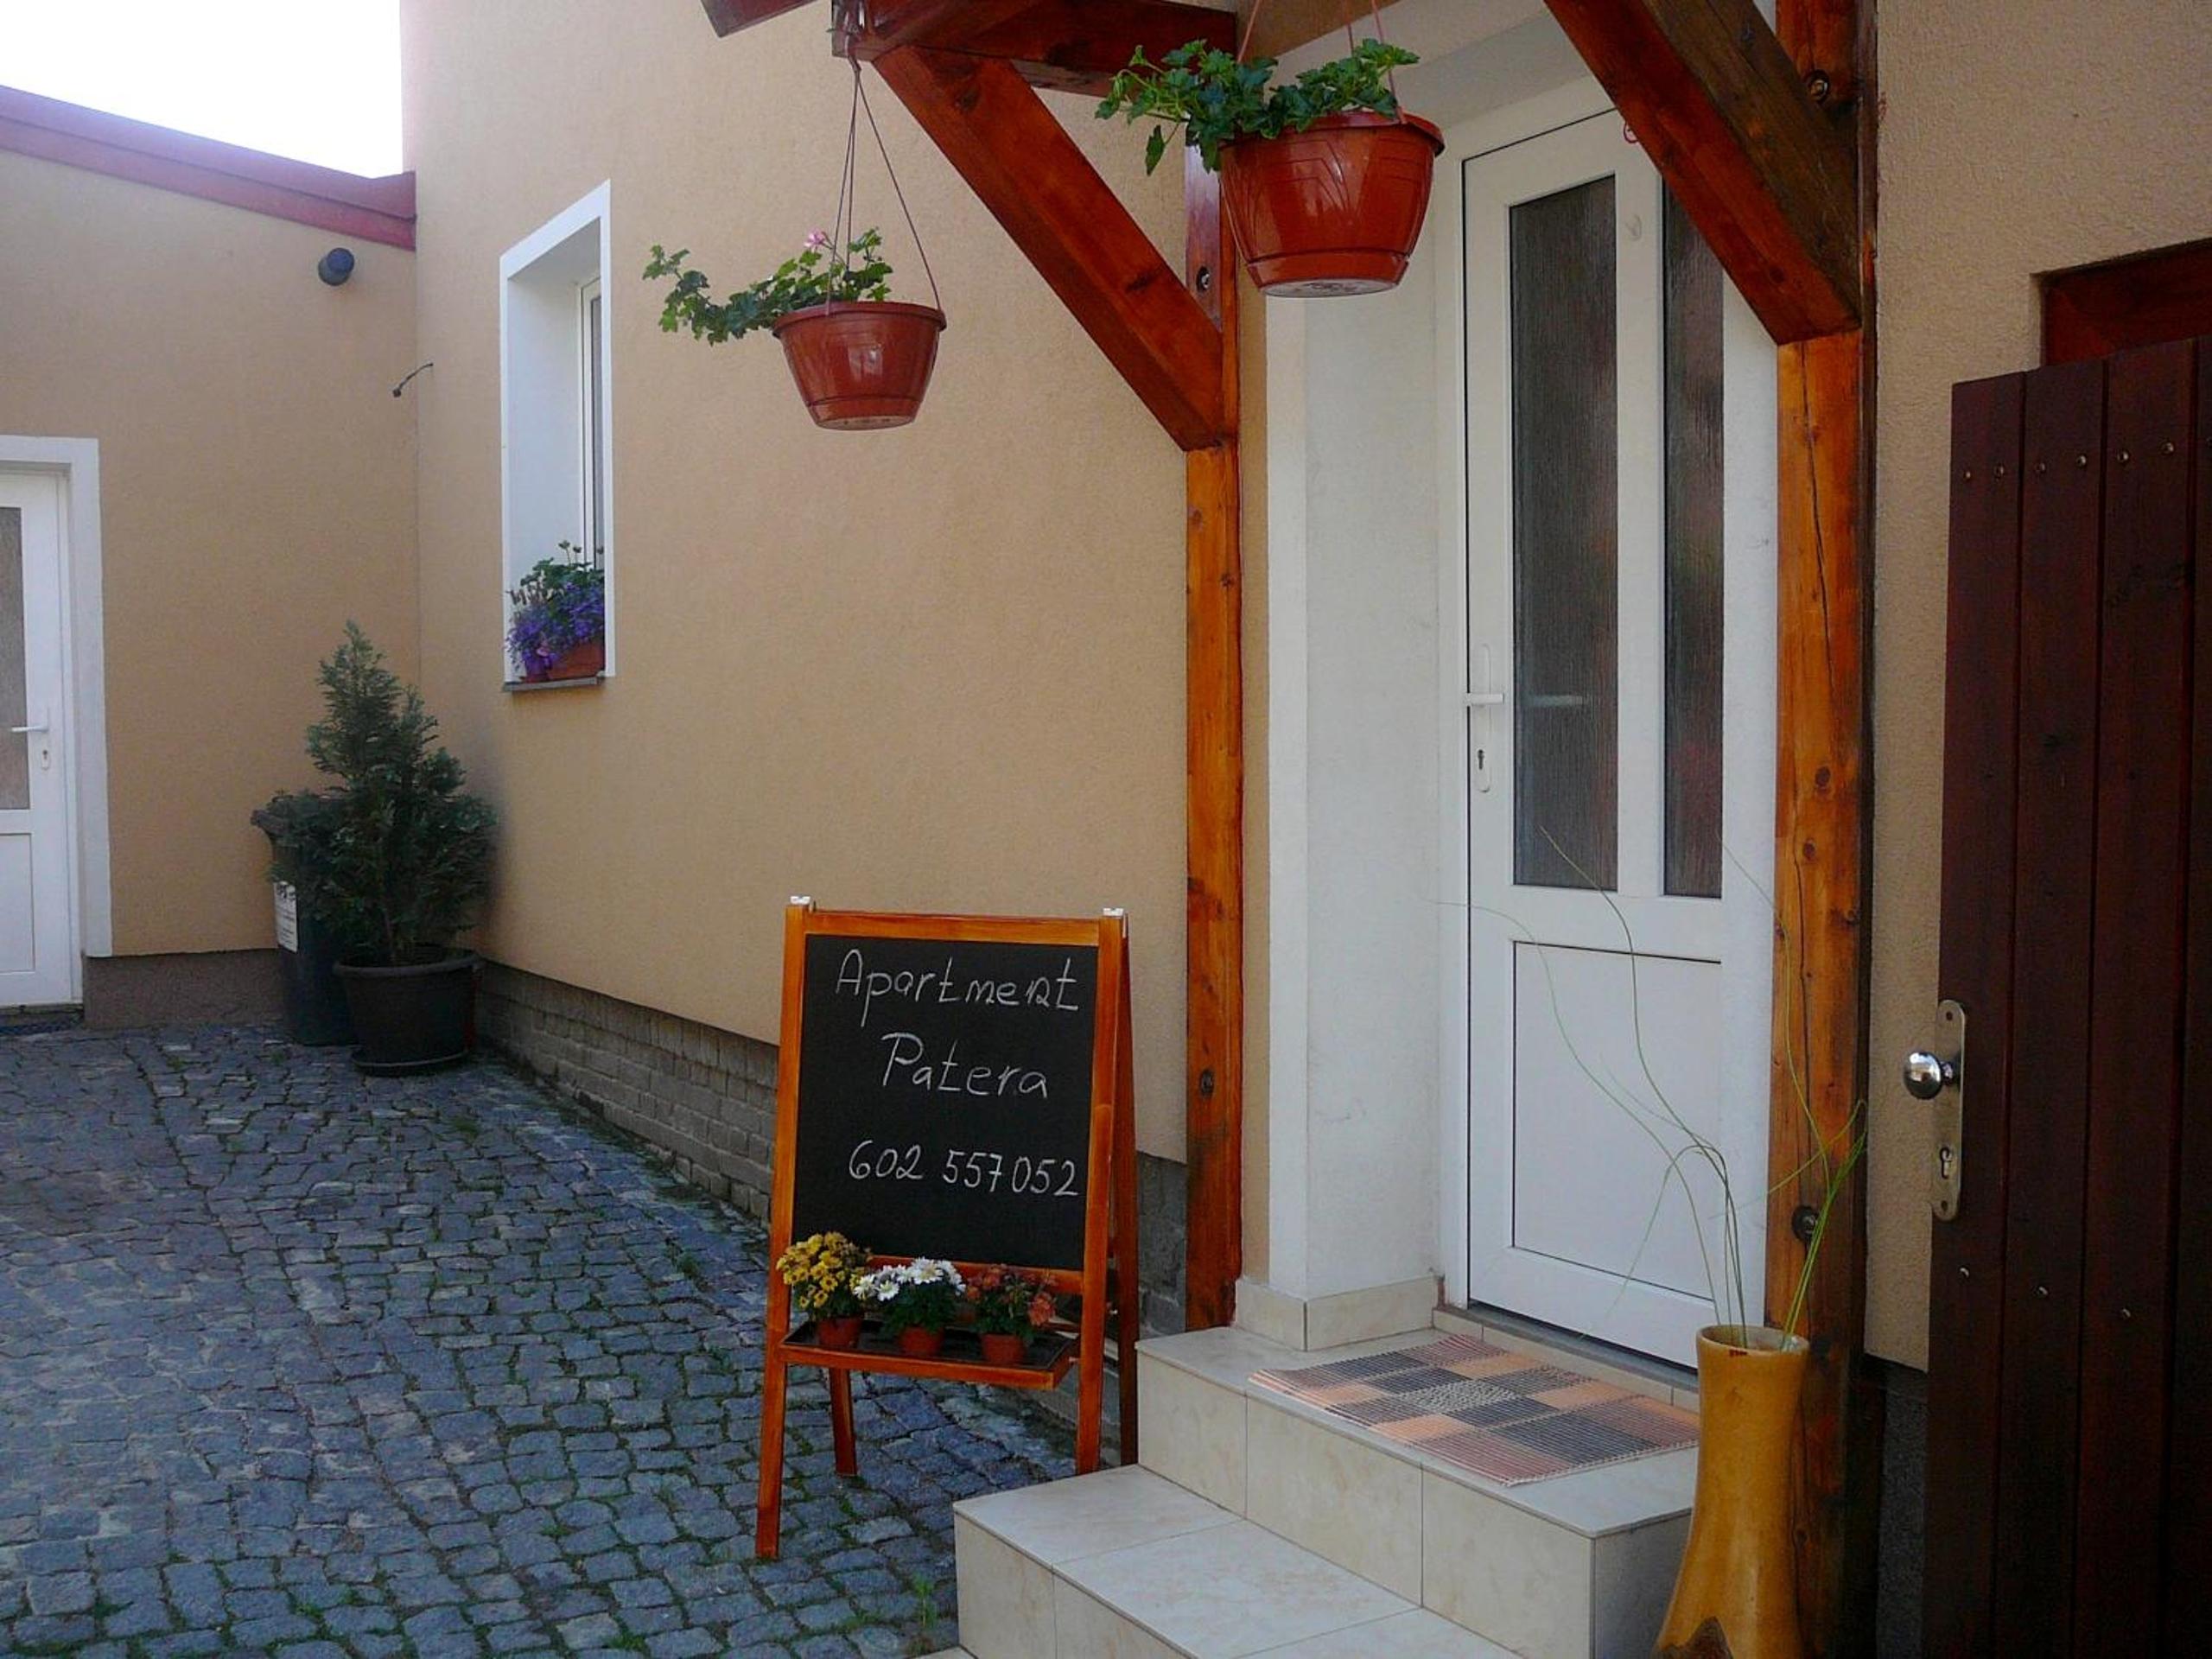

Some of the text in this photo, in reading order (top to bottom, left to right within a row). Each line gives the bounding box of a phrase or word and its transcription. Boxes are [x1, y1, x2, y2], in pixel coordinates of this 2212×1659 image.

[836, 949, 1078, 1027] Apartment
[880, 1032, 1047, 1098] Patera
[849, 1140, 923, 1180] 602
